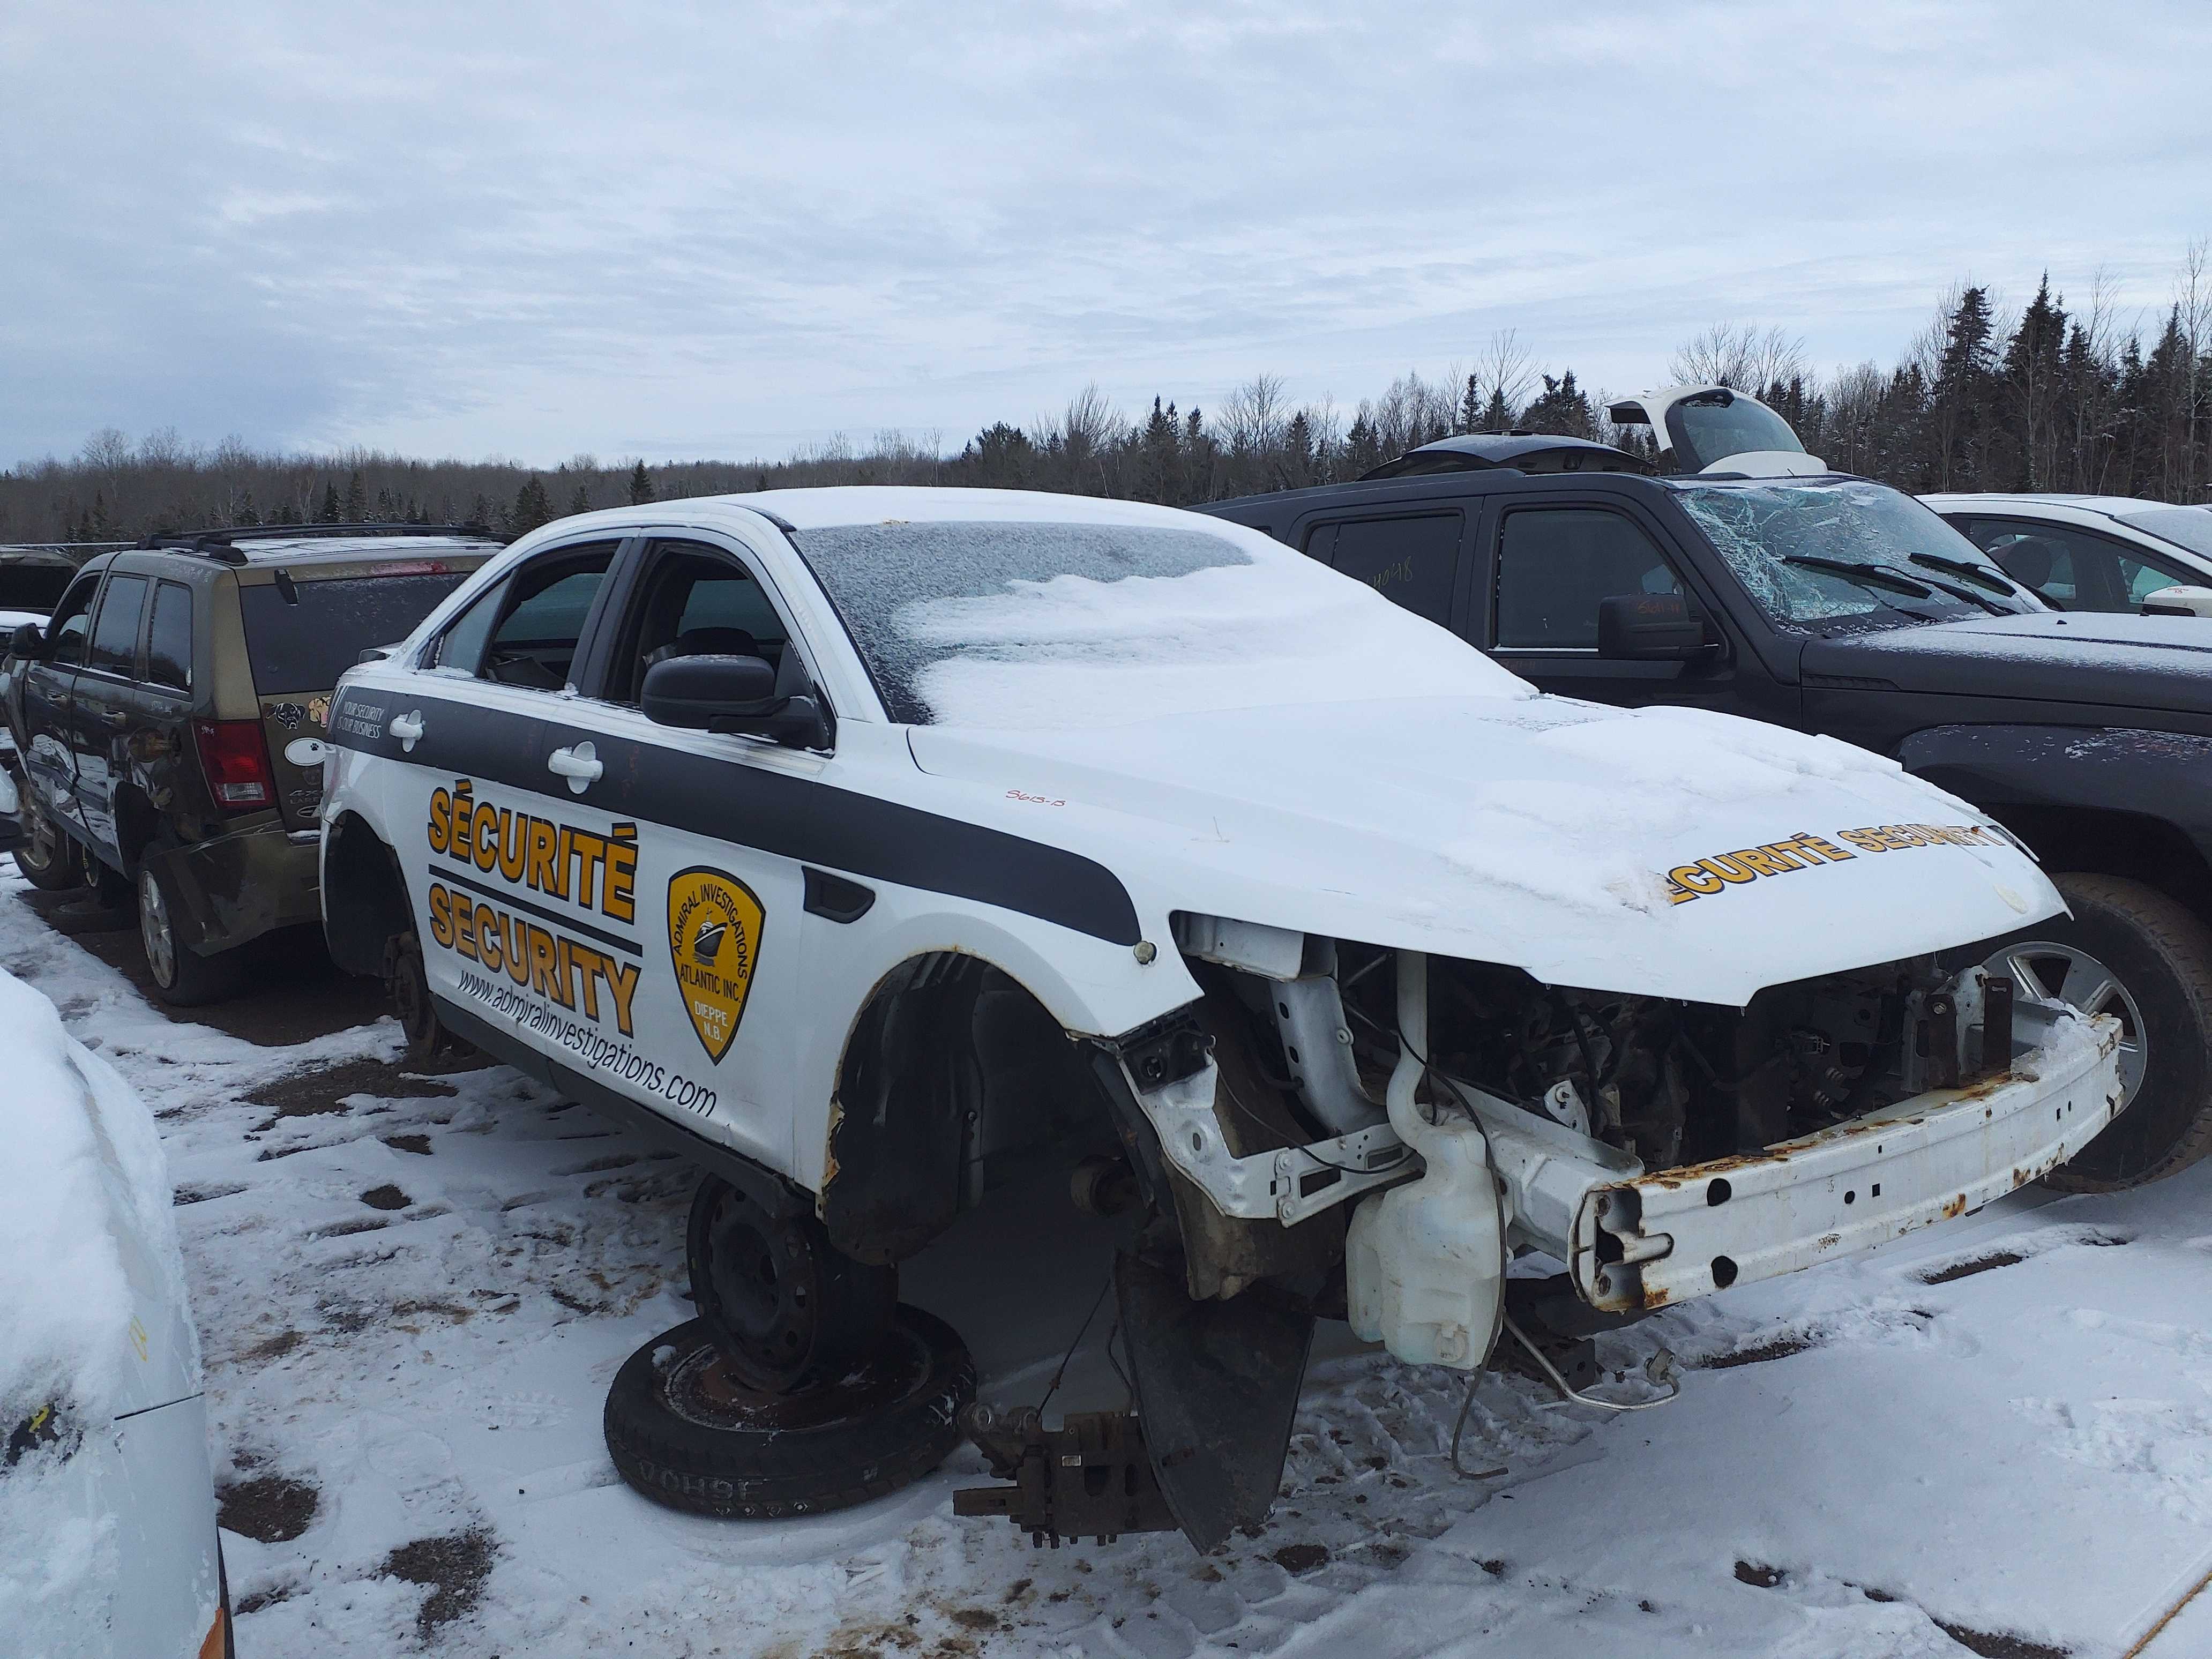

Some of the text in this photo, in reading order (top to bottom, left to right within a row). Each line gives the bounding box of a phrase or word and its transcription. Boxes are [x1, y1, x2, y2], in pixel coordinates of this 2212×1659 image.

[342, 718, 354, 731] OUR
[352, 720, 382, 739] BUSINESS
[343, 701, 385, 722] YOUR SECURITY
[428, 779, 639, 925] SÉCURITÉ
[672, 883, 748, 980] ADMIRAL INVESTIGATIONS
[429, 883, 642, 1040] SECURITY
[679, 963, 742, 1004] ATLANTIC INC.
[694, 1000, 728, 1028] DIEPPE
[703, 1021, 723, 1042] N.B.
[458, 969, 717, 1118] www.admiralinvestigations.com
